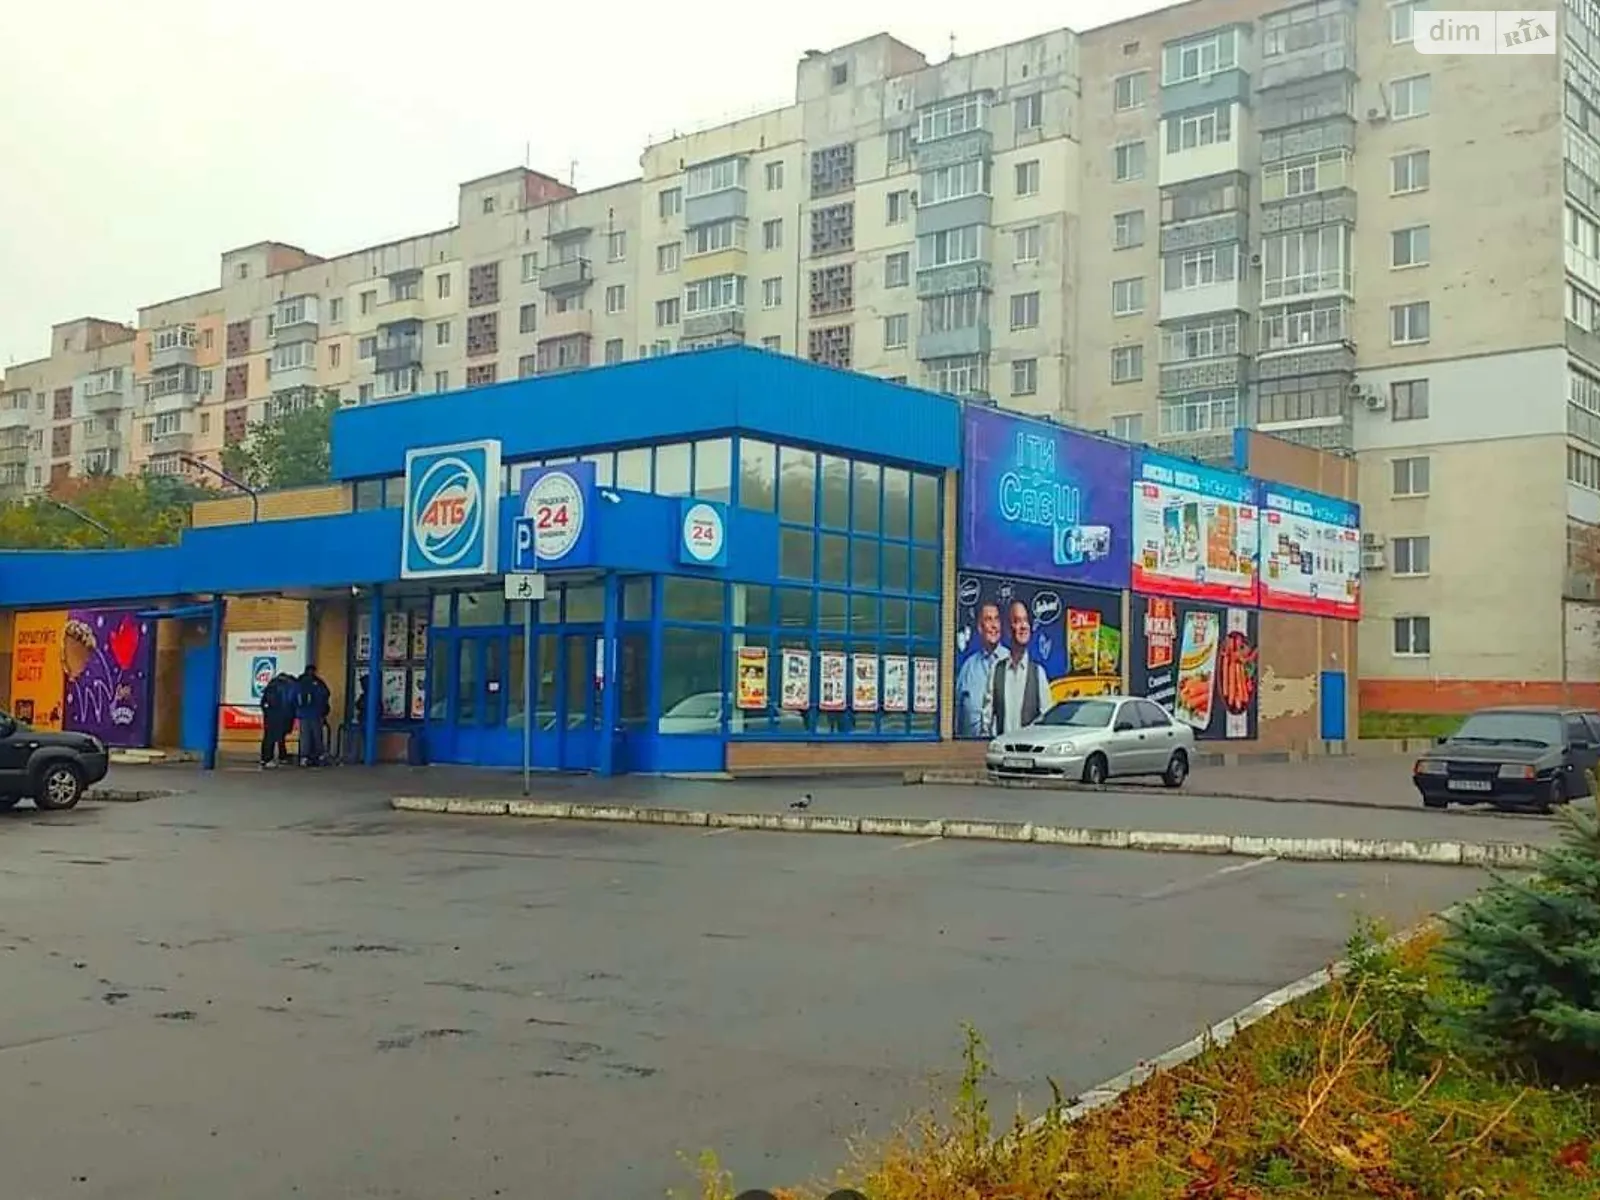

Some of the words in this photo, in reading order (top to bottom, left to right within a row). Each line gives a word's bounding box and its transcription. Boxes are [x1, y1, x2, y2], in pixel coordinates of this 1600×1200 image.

[424, 497, 467, 526] АТБ
[537, 505, 569, 528] 24
[517, 523, 531, 566] P
[692, 526, 714, 540] 24
